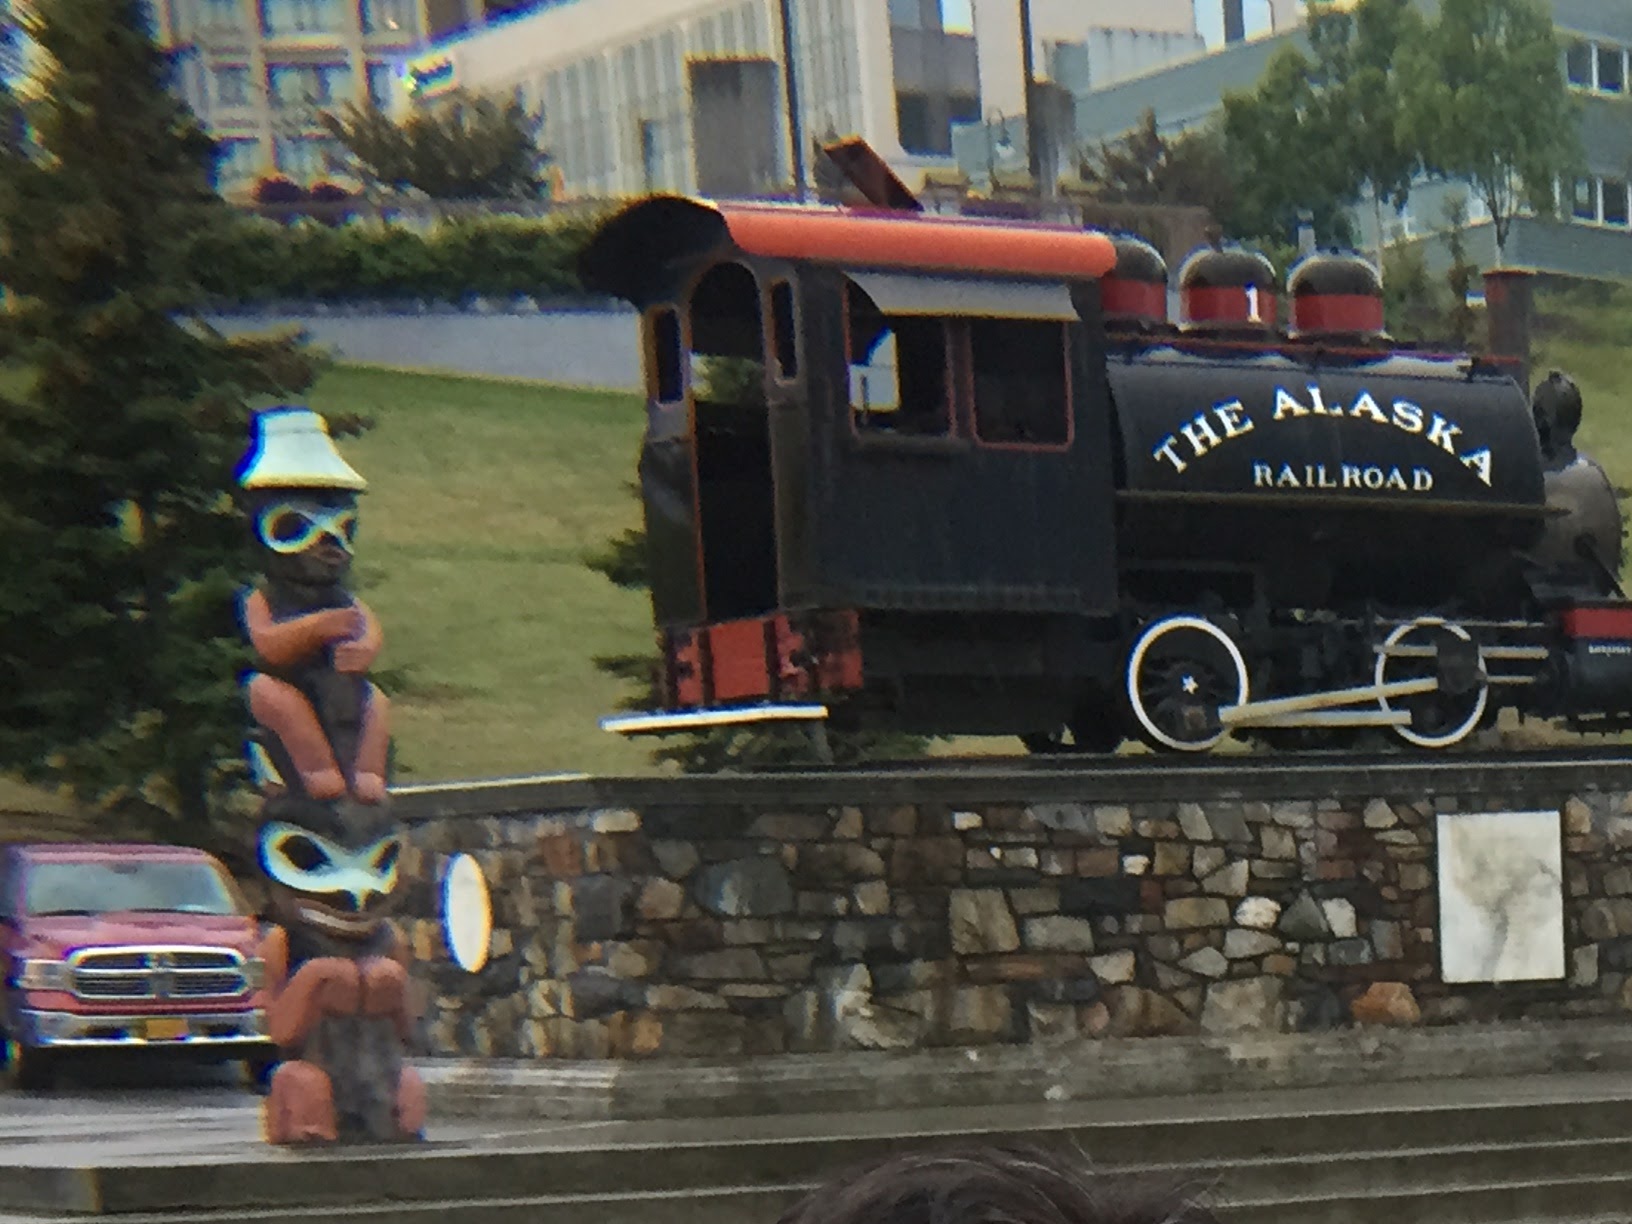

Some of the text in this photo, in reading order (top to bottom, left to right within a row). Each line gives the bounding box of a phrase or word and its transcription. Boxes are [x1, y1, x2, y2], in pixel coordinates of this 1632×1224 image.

[1245, 283, 1262, 323] 1
[1153, 381, 1493, 488] THE ALASKA
[1252, 459, 1434, 492] RAILROAD
